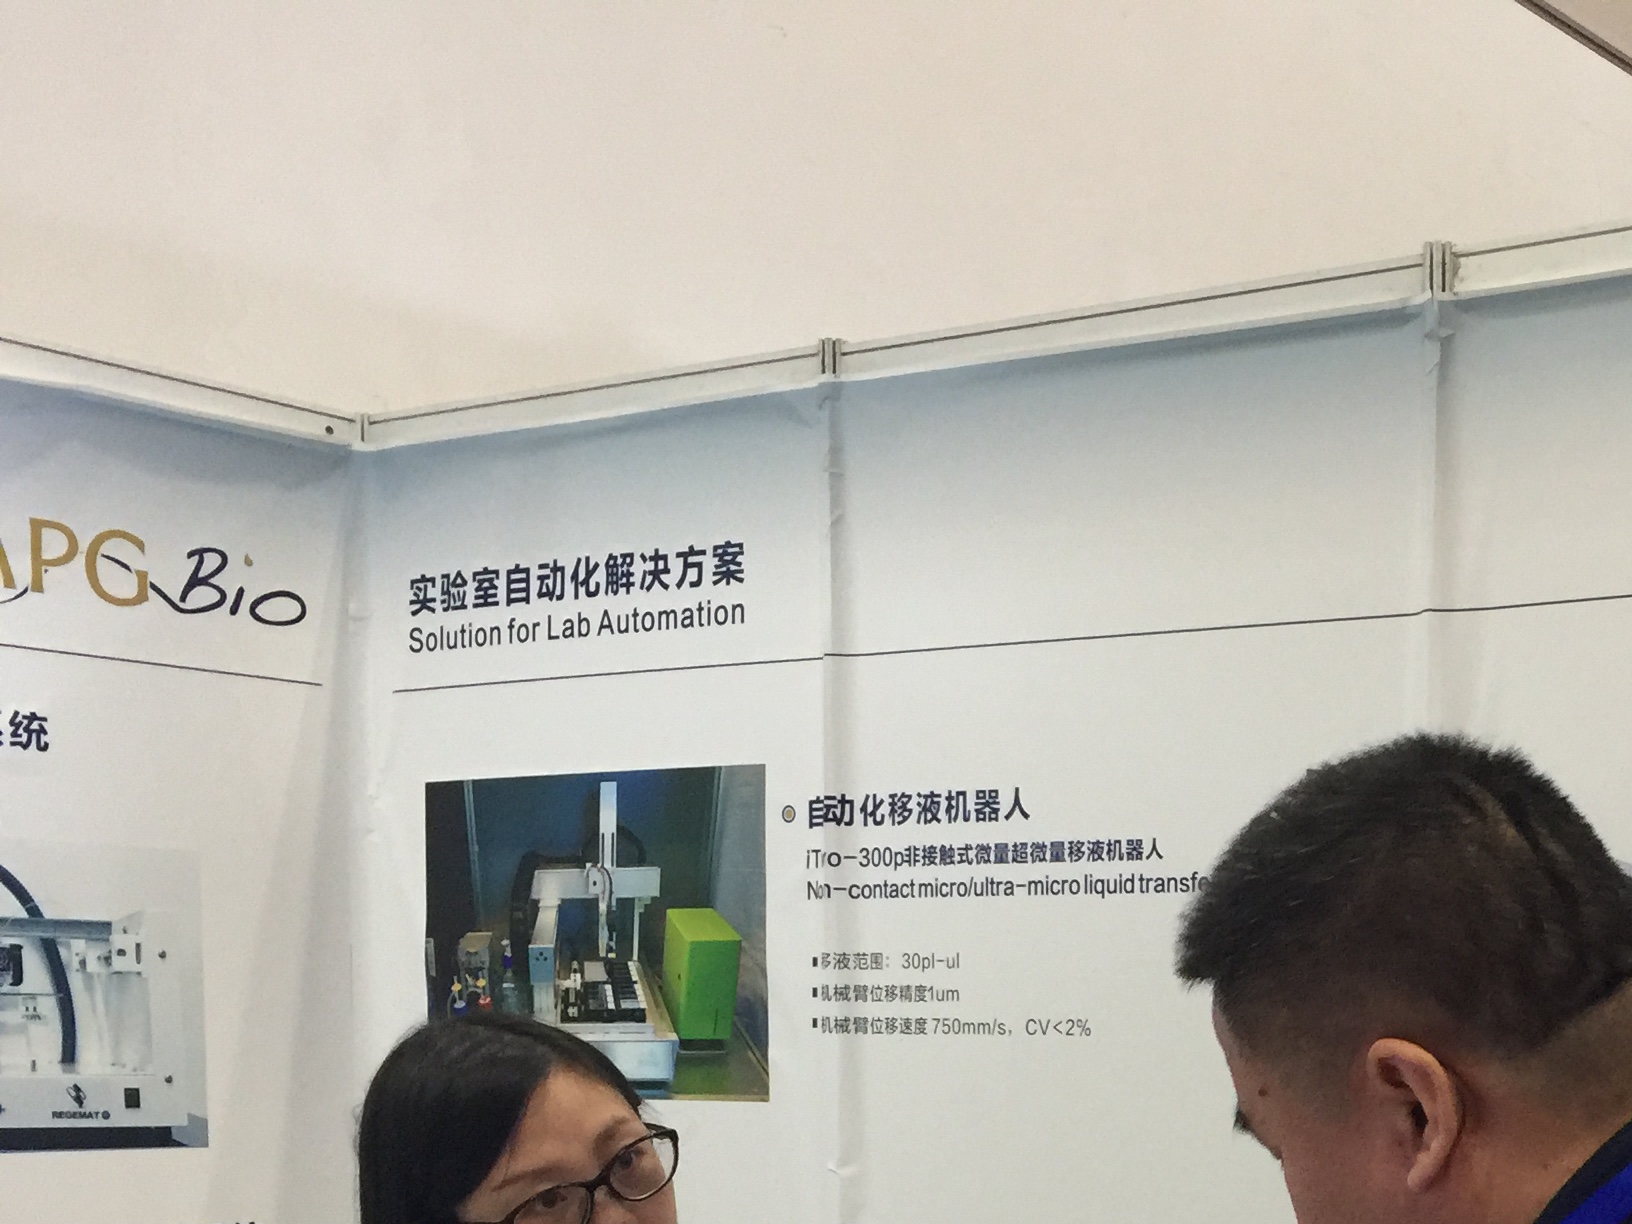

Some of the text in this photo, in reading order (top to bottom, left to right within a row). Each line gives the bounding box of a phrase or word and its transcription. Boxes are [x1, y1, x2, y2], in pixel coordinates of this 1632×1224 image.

[409, 540, 745, 616] 实验室自动化解决方案
[409, 600, 745, 653] Solution for Lab Automation
[0, 710, 49, 751] 统
[808, 787, 1030, 829] 自动化移液机器人
[918, 874, 1081, 899] micro/ultra-micro
[1084, 873, 1136, 899] liquid
